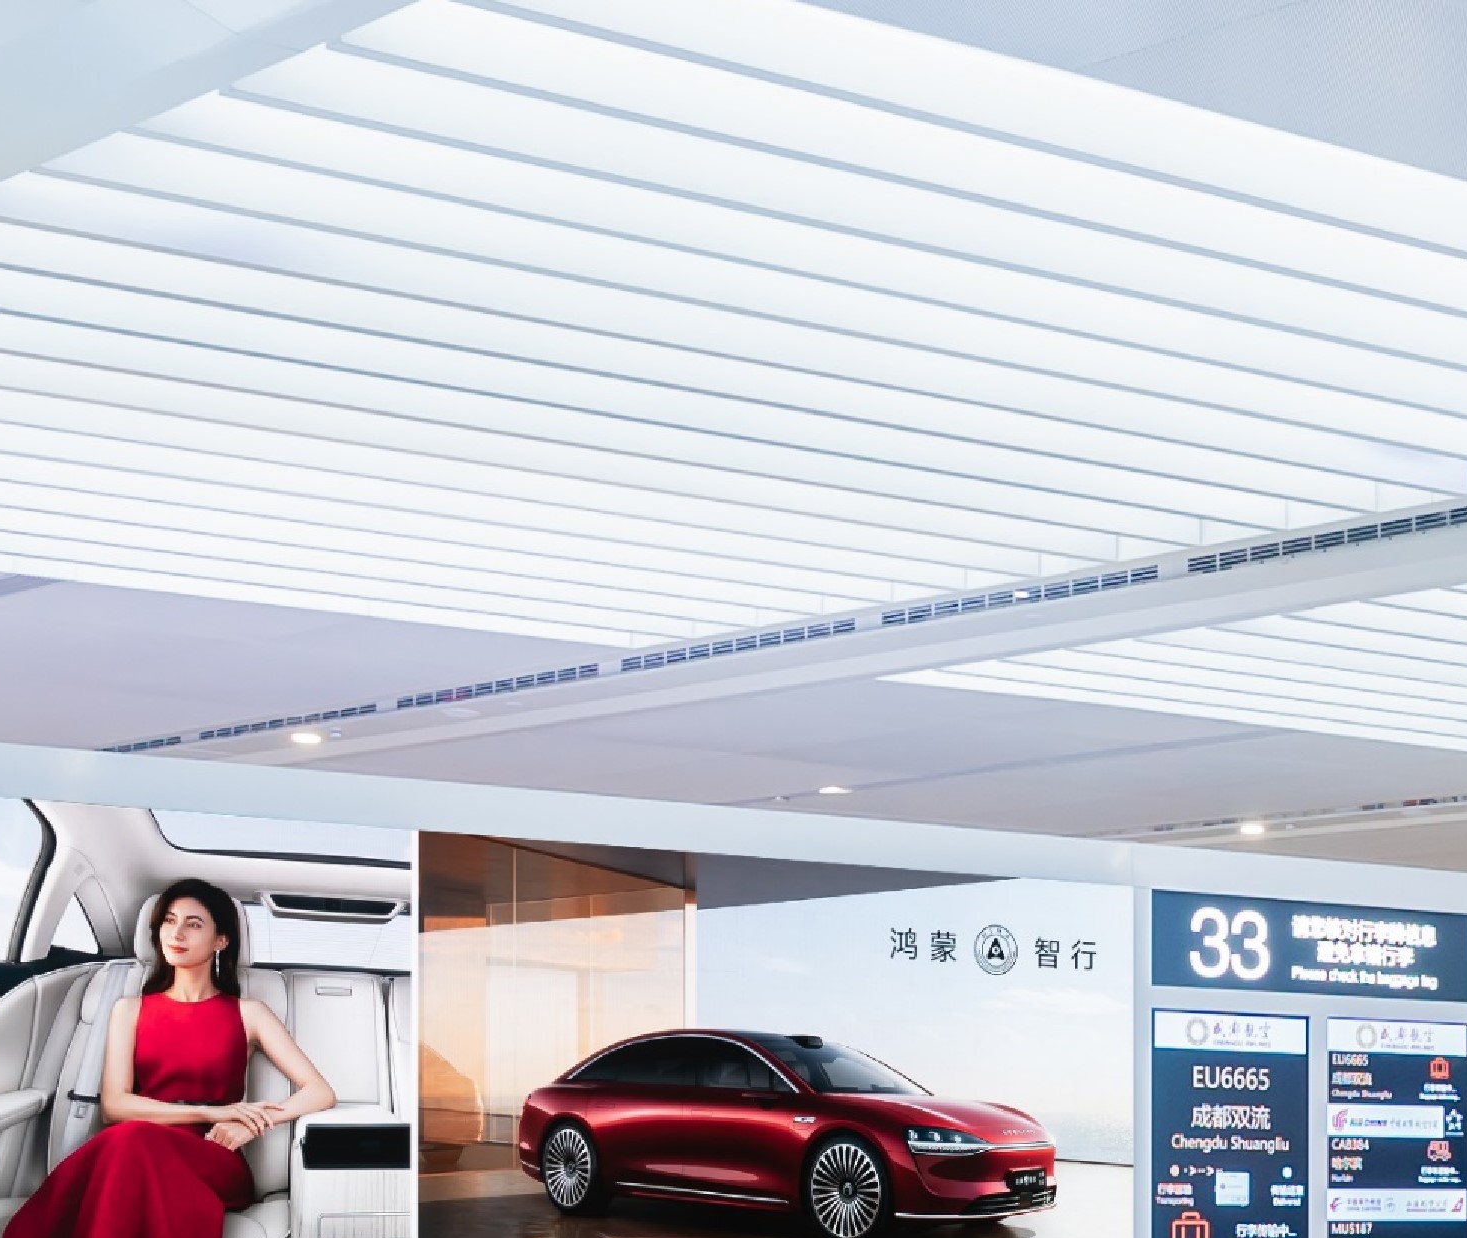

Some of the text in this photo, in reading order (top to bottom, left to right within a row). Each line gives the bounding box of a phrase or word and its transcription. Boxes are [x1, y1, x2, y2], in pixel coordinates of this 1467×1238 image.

[890, 927, 1097, 970] 鸿蒙 智行
[1189, 906, 1270, 980] 33
[1192, 1065, 1270, 1091] EU6665
[1190, 1103, 1271, 1130] 成都双流
[1171, 1132, 1290, 1155] Chengdu Shuangliu
